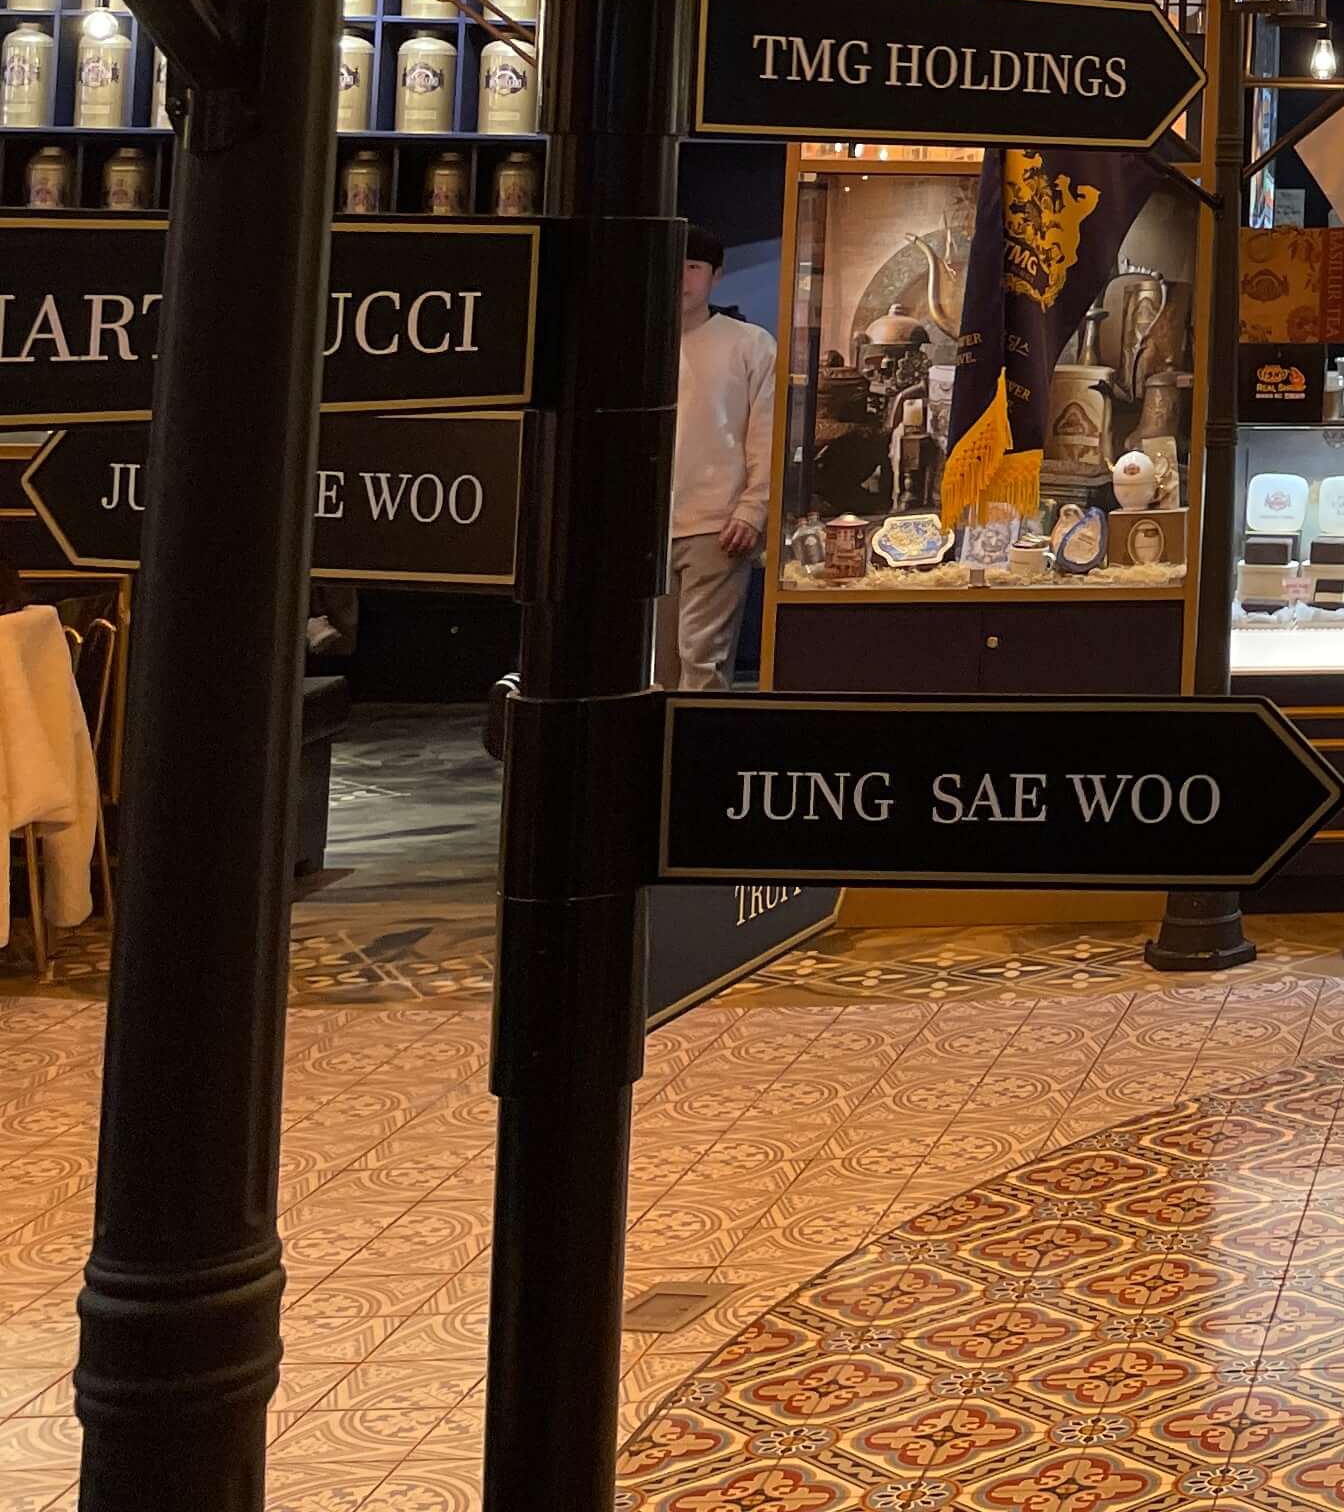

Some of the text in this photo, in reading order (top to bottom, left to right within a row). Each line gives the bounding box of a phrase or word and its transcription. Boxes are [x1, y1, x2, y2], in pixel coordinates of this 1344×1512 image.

[752, 33, 1129, 99] TMG HOLDINGS
[360, 473, 485, 526] WOO
[725, 769, 1222, 826] JUNG SAE WOO
